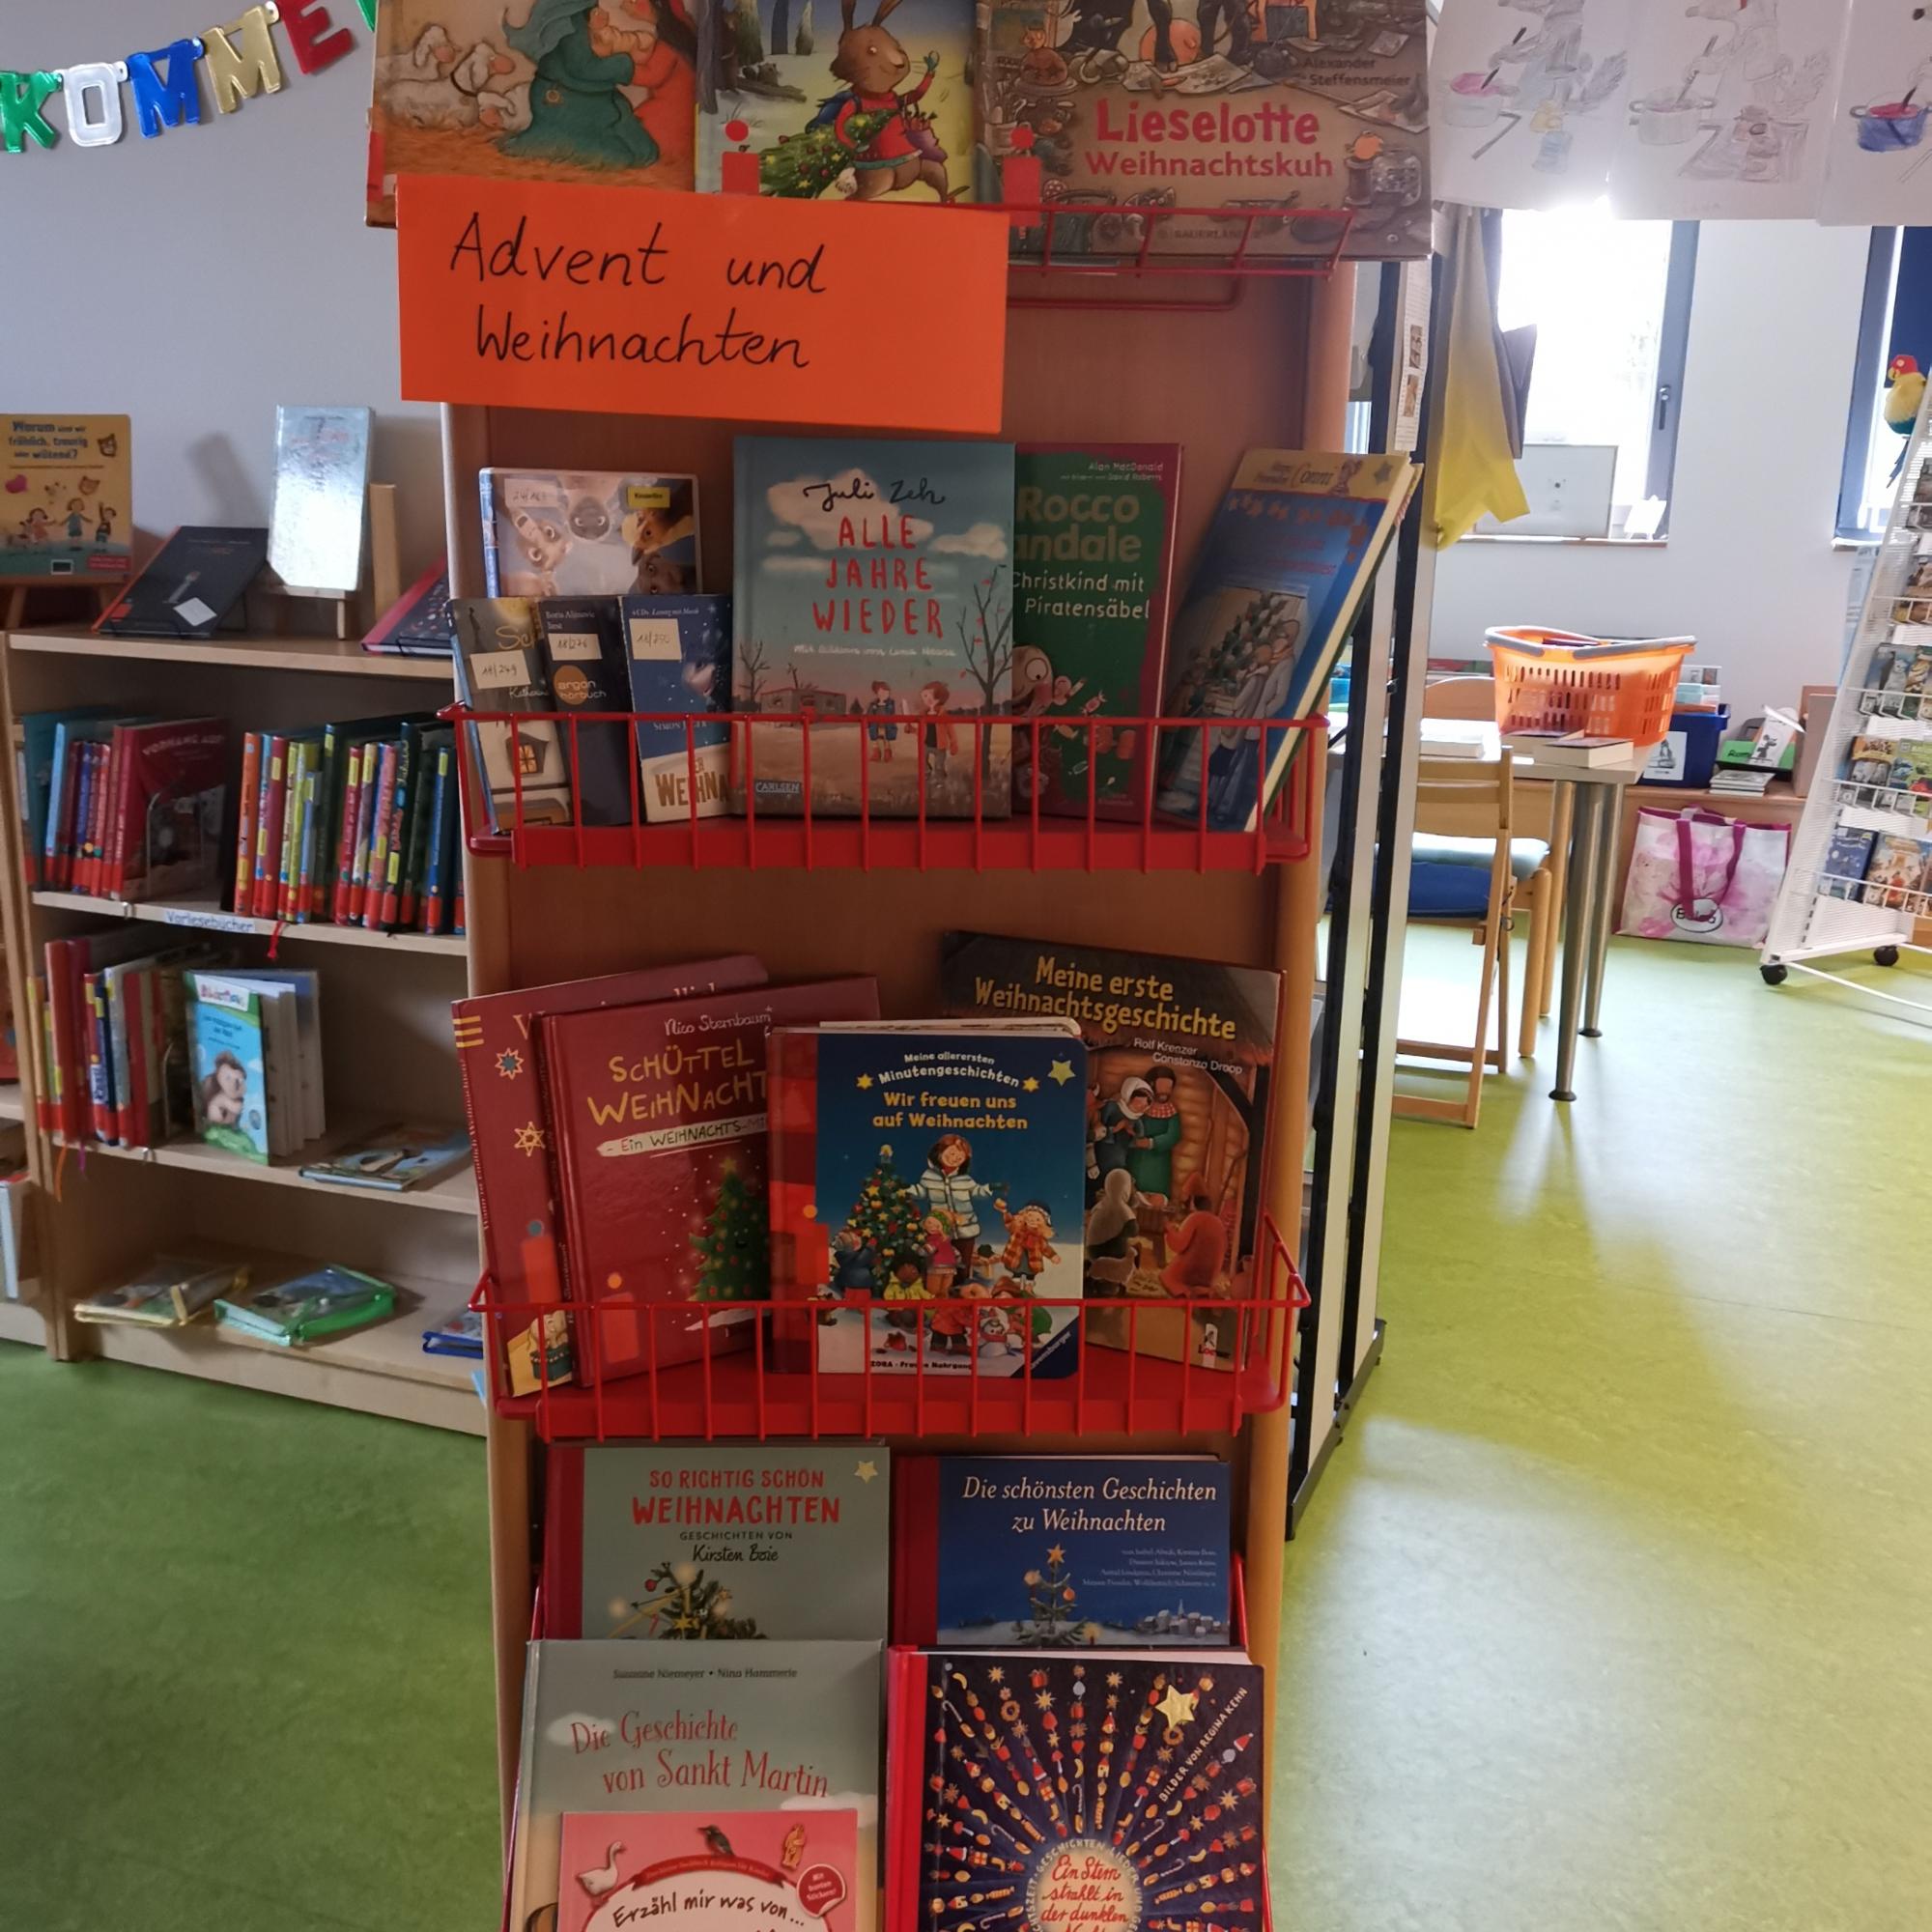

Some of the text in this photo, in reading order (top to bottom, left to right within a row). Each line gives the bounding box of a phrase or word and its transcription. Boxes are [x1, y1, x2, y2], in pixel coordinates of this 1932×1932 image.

[1304, 55, 1377, 70] Alexander
[1308, 71, 1412, 88] Steffensmeier
[1095, 98, 1321, 145] Lieselotte
[1084, 151, 1333, 179] Weihnachtskuh
[449, 211, 828, 293] Advent und
[476, 302, 810, 369] Weihnachten
[803, 477, 947, 512] Juli Zeh
[1016, 487, 1141, 524] Rocco
[838, 515, 918, 550] ALLE
[1013, 523, 1142, 563] andale
[825, 556, 934, 592] JAHRE
[1012, 569, 1145, 593] Christkind mit
[811, 598, 944, 639] WIEDER
[1024, 595, 1151, 619] Piratensäbel
[557, 680, 597, 692] argon
[755, 781, 800, 794] CARLSEN
[1035, 955, 1174, 1002] Meine erste
[975, 976, 1236, 1041] Weihnachtsgeschichte
[665, 1018, 696, 1037] Nico
[904, 1050, 995, 1065] Meine allerersten
[1133, 1037, 1198, 1056] Rolf Krenzer
[608, 1037, 755, 1083] SCHÜTTEL
[1209, 1059, 1243, 1076] Droop
[878, 1064, 1020, 1089] Minutengeschichten
[884, 1091, 1017, 1110] Wir freuen uns
[872, 1111, 1029, 1131] auf Weihnachten
[621, 1137, 643, 1152] Ein
[649, 1468, 673, 1489] SO
[679, 1468, 755, 1489] RICHTIG
[962, 1476, 1217, 1501] Die schönsten Geschichten
[633, 1495, 841, 1526] WEIHNACHTEN
[1011, 1508, 1166, 1533] zu Weihnachten
[679, 1530, 794, 1542] GESCHICHTEN VON
[692, 1543, 780, 1563] Kirsten Boie
[571, 1708, 739, 1755] Die Geschichte
[1159, 1687, 1249, 1803] BILDER VON REGINA KEHN
[603, 1747, 829, 1799] von Sankt Martin
[1052, 1854, 1079, 1882] Ein
[1041, 1882, 1124, 1901] strahlt in
[612, 1890, 677, 1929] Erzähl
[684, 1889, 716, 1911] mir
[720, 1891, 755, 1914] was
[1040, 1902, 1129, 1922] der dunklen
